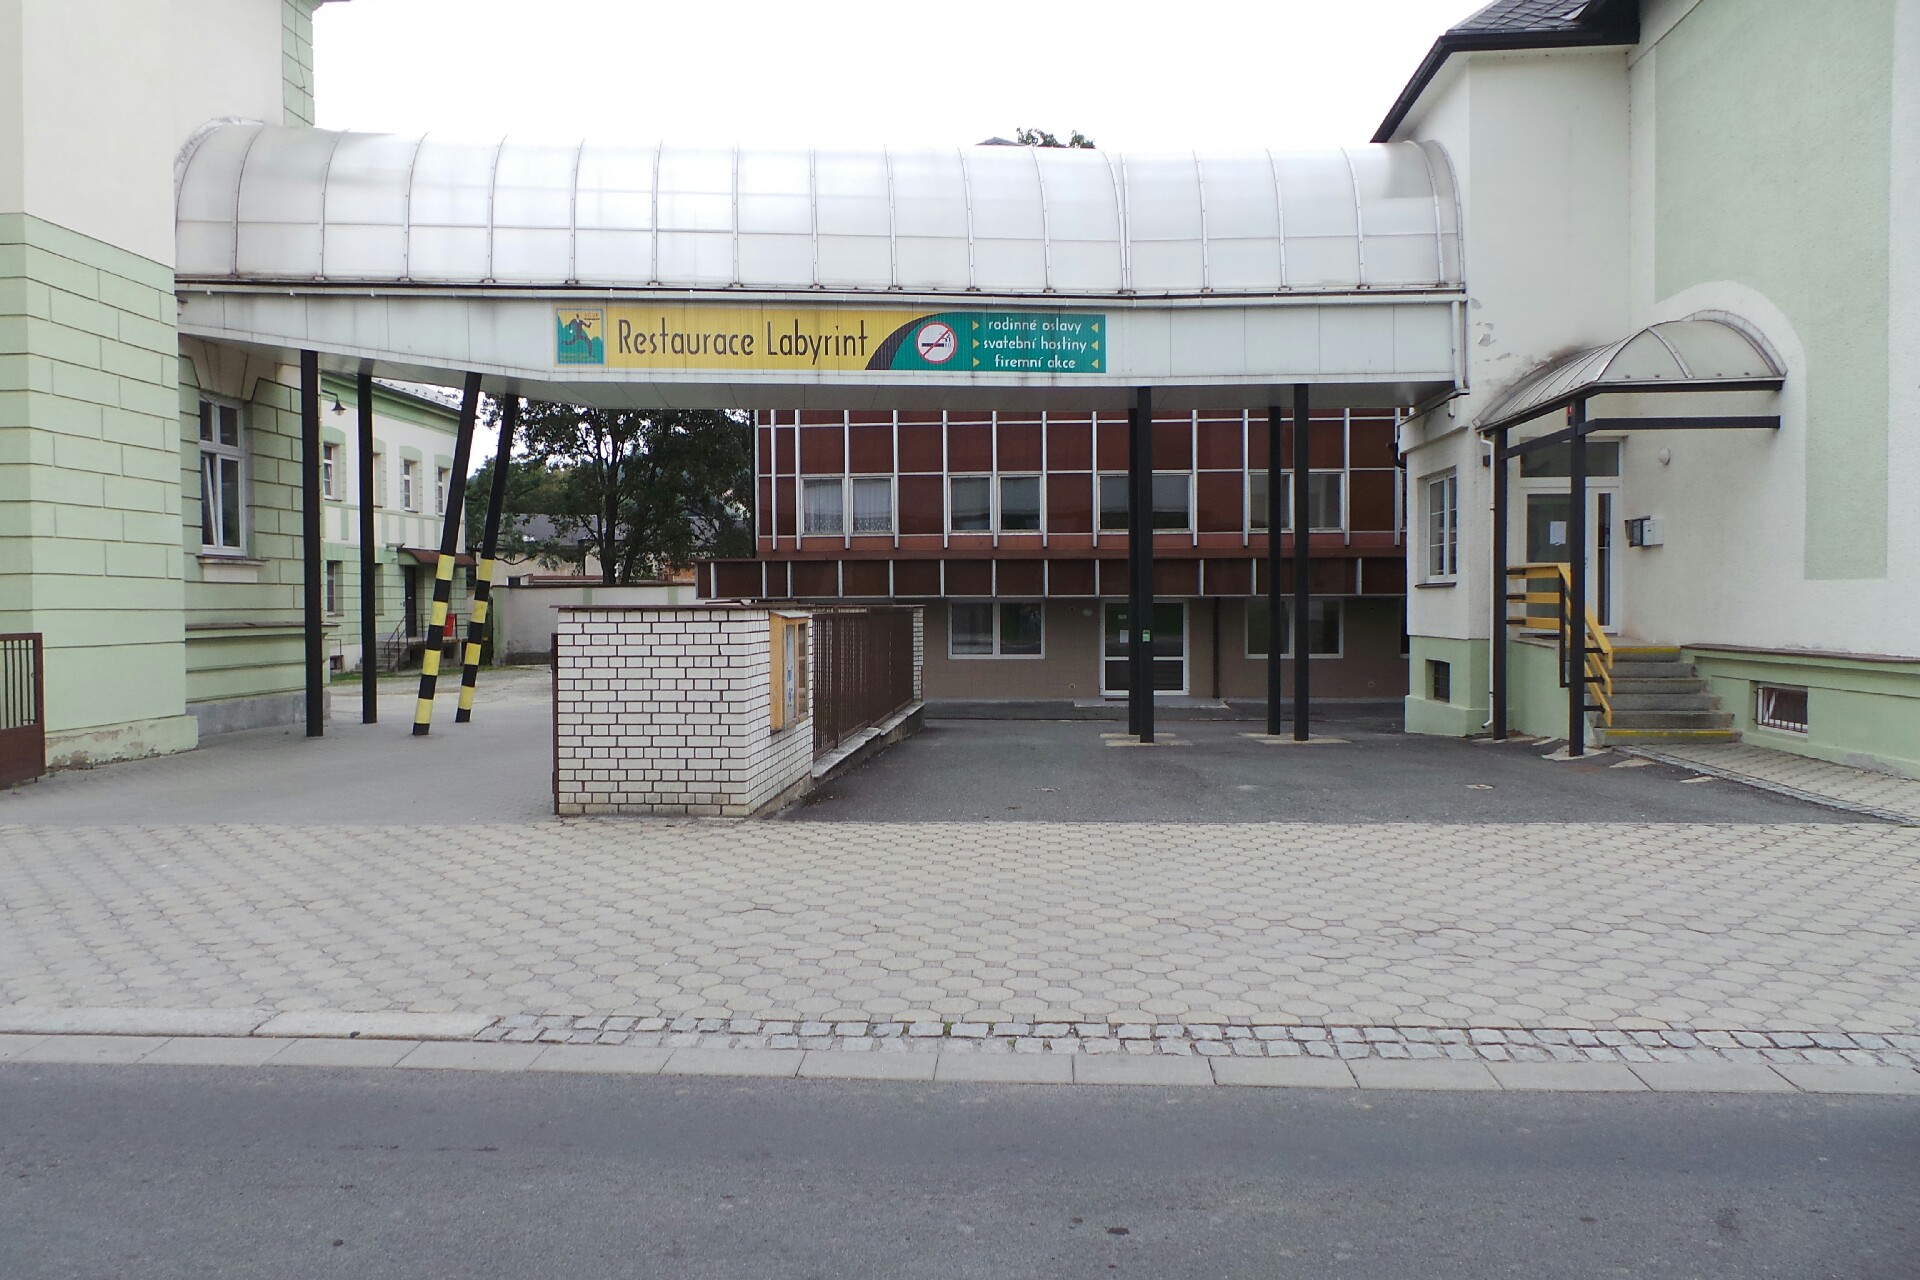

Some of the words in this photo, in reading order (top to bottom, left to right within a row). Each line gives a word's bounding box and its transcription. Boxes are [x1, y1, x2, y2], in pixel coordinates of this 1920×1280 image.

[989, 317, 1037, 331] rodinné
[1042, 318, 1081, 335] oslavy
[618, 317, 755, 355] Restaurace
[767, 319, 869, 365] Labyrint
[984, 335, 1036, 350] svatební
[1041, 335, 1087, 353] hostiny
[995, 354, 1043, 368] firemní
[1048, 355, 1076, 369] akce
